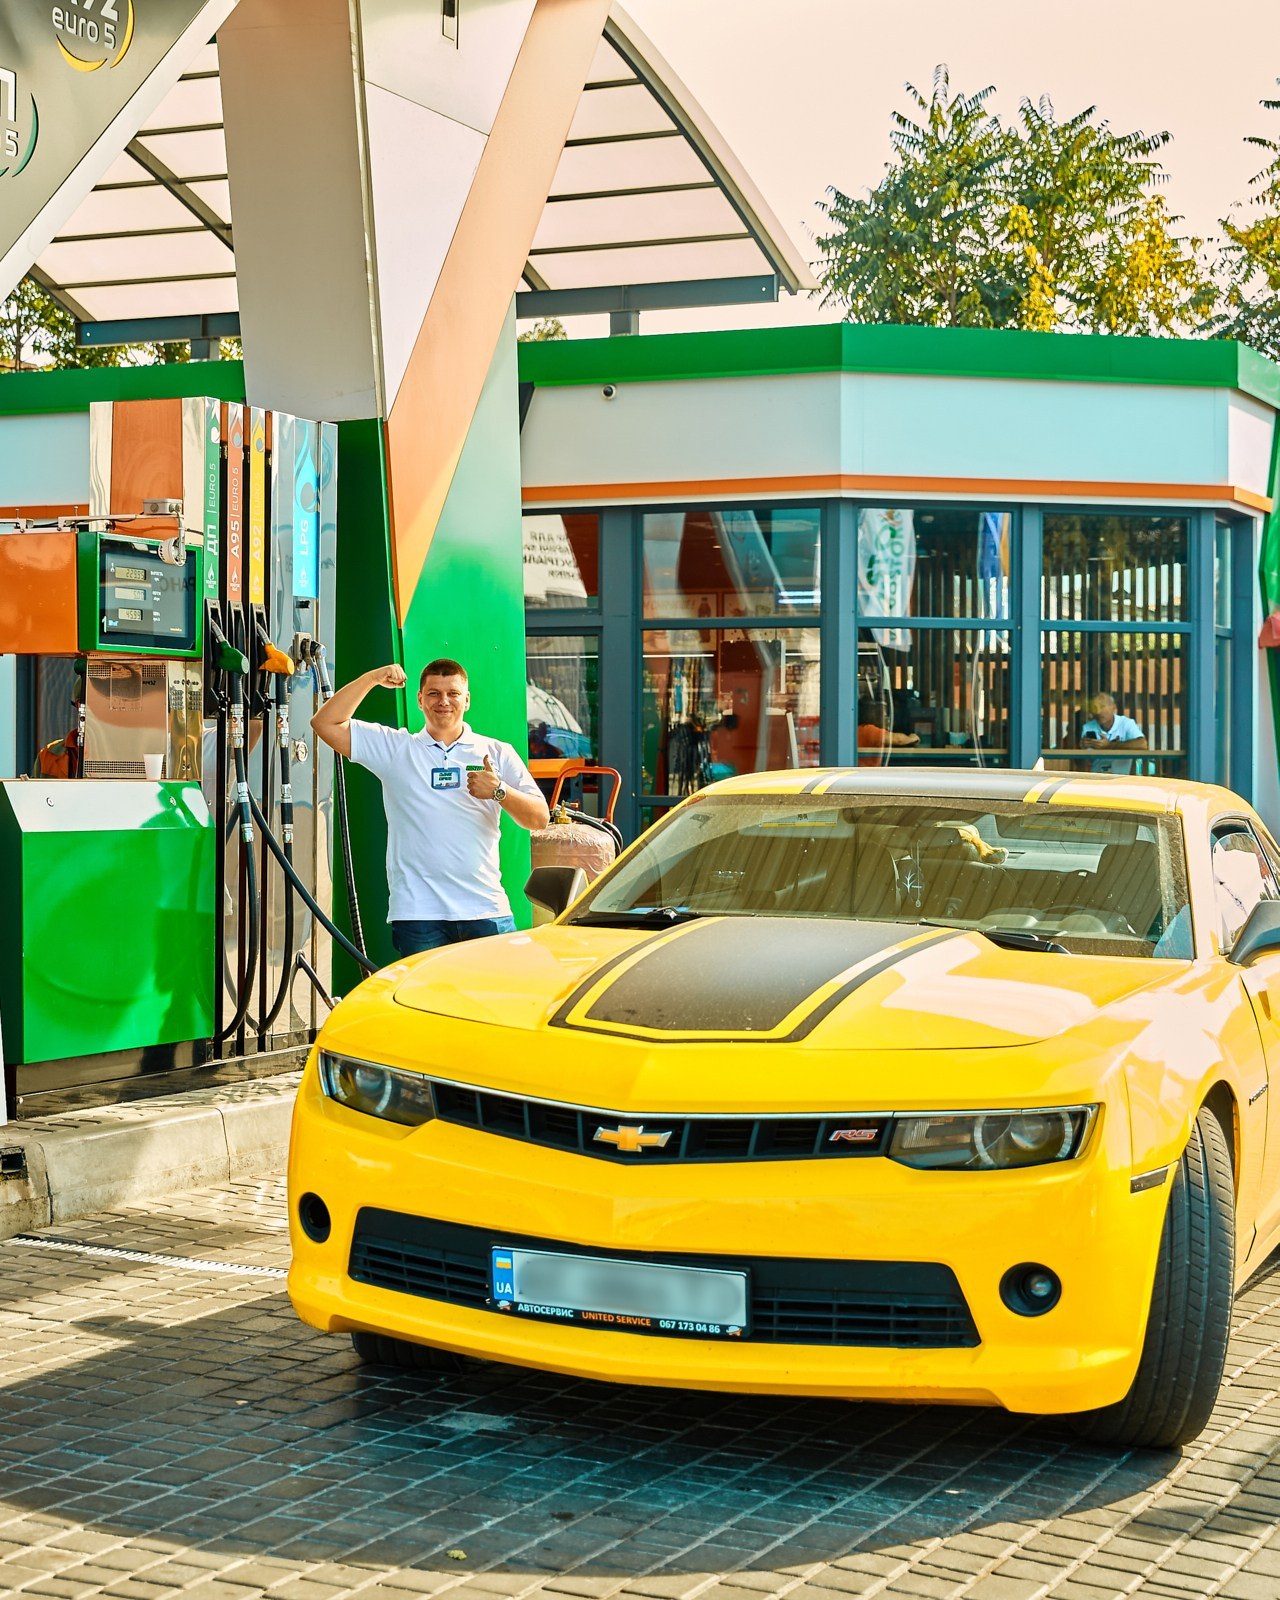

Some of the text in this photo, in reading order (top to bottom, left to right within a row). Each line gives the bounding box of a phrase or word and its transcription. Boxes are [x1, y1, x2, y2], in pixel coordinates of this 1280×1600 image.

[52, 6, 99, 43] euro
[104, 22, 116, 49] 5
[207, 524, 218, 556] ДП
[231, 520, 240, 559] A95
[300, 519, 309, 556] LPG
[829, 1129, 878, 1141] RS
[496, 1281, 512, 1294] UA
[518, 1303, 720, 1334] АВТОСЕРВИС UNITED SERVICE 067 173 04 86
